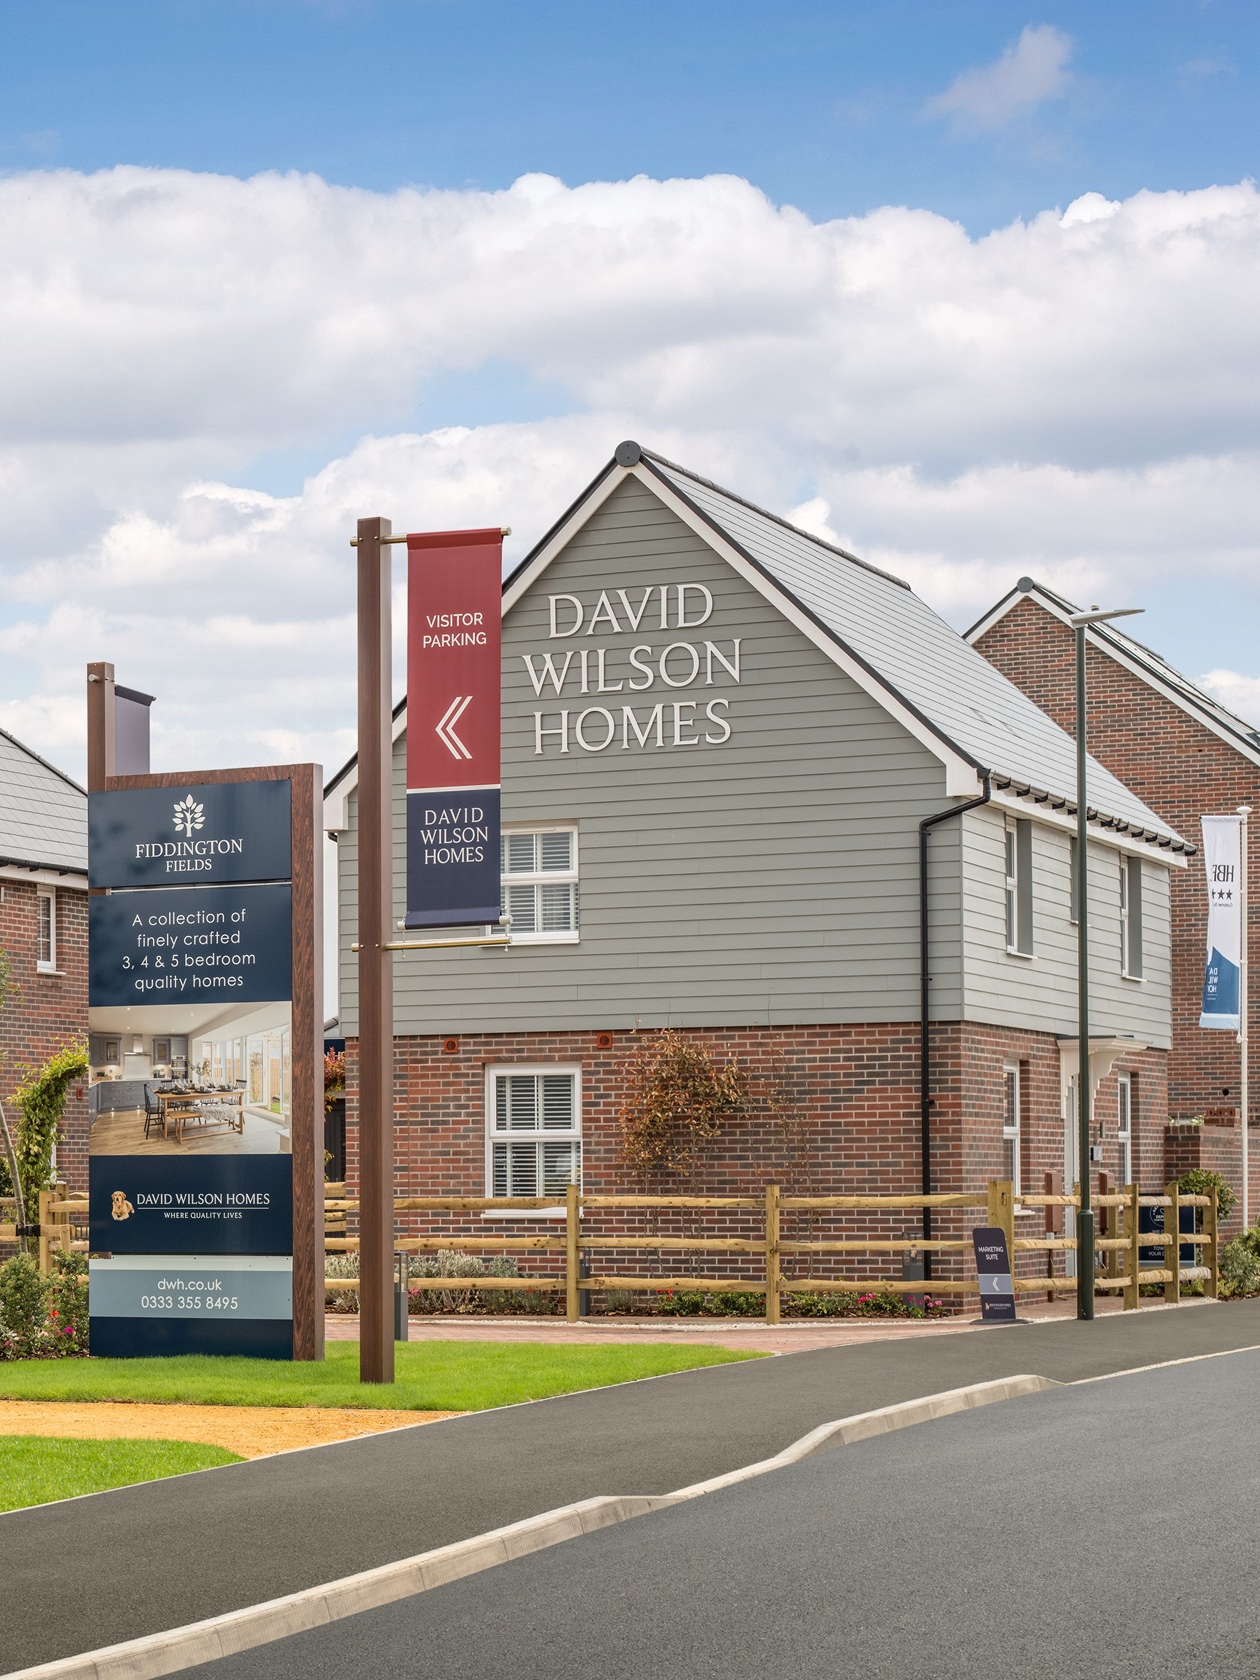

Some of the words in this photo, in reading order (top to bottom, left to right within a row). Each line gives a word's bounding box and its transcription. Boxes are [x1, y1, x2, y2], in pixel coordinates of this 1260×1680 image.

[548, 583, 714, 639] DAVID
[426, 612, 483, 629] VISITOR
[423, 632, 487, 648] PARKING
[522, 638, 742, 698] WILSON
[533, 698, 731, 755] HOMES
[424, 807, 483, 826] DAVID
[420, 826, 488, 845] WILSON
[135, 839, 243, 858] FIDDINGTON
[424, 846, 484, 865] HOMES
[166, 859, 212, 872] FIELDS
[132, 914, 143, 927] A
[148, 910, 225, 926] collection
[231, 909, 246, 922] of
[137, 933, 178, 949] finely
[184, 931, 240, 946] crafted
[122, 956, 135, 970] 3,
[141, 955, 149, 968] 4
[154, 955, 165, 968] &
[170, 954, 179, 967] 5
[184, 953, 256, 966] bedroom
[134, 976, 186, 992] quality
[193, 974, 243, 987] homes
[137, 1194, 172, 1205] DAVID
[175, 1194, 223, 1205] WILSON
[226, 1194, 270, 1205] HOMES
[158, 1278, 222, 1290] dwh.co.uk
[141, 1296, 173, 1308] 0333
[177, 1297, 201, 1309] 355
[206, 1297, 238, 1310] 8495
